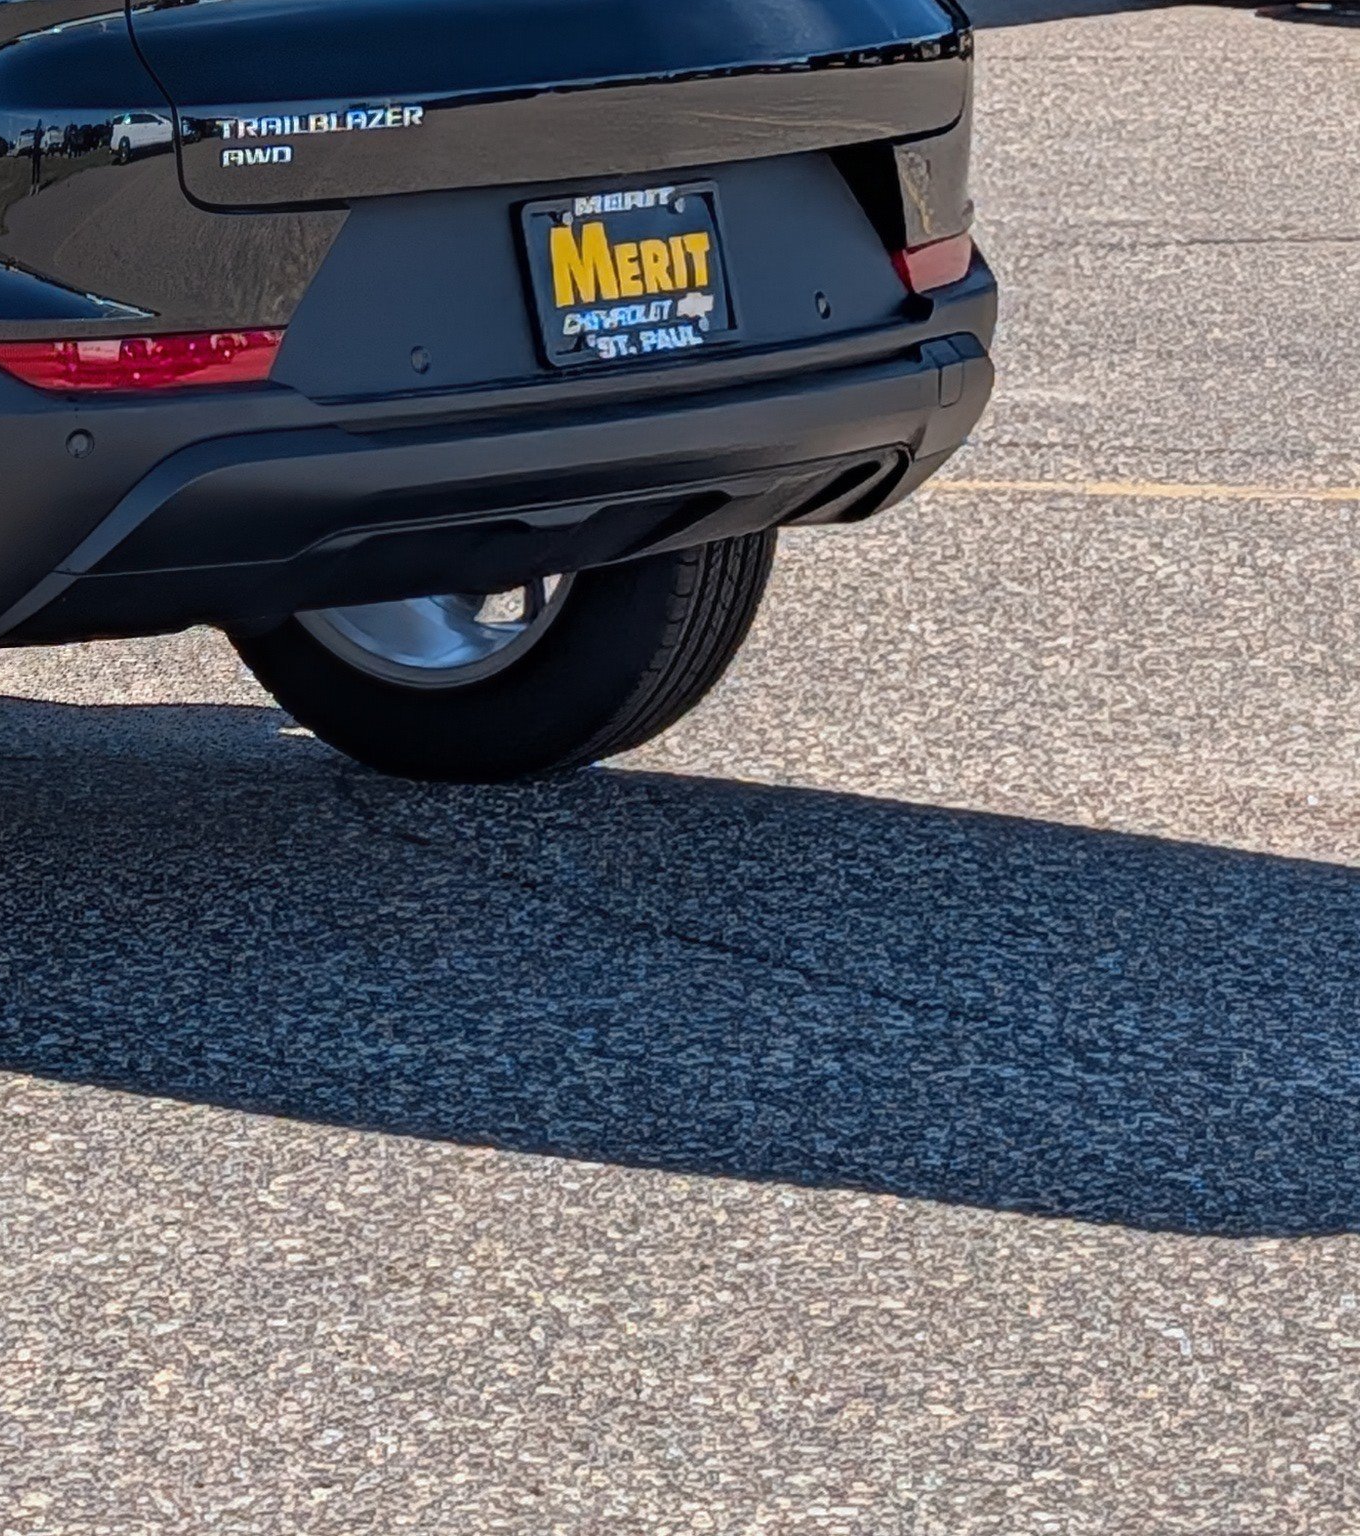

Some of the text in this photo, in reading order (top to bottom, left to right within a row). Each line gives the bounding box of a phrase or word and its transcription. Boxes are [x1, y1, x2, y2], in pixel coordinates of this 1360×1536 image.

[217, 105, 423, 140] TRAILBLAZER
[222, 145, 292, 167] AWD
[574, 186, 676, 216] MERIT
[550, 221, 710, 308] MERIT
[597, 324, 704, 359] ST. PAUL
